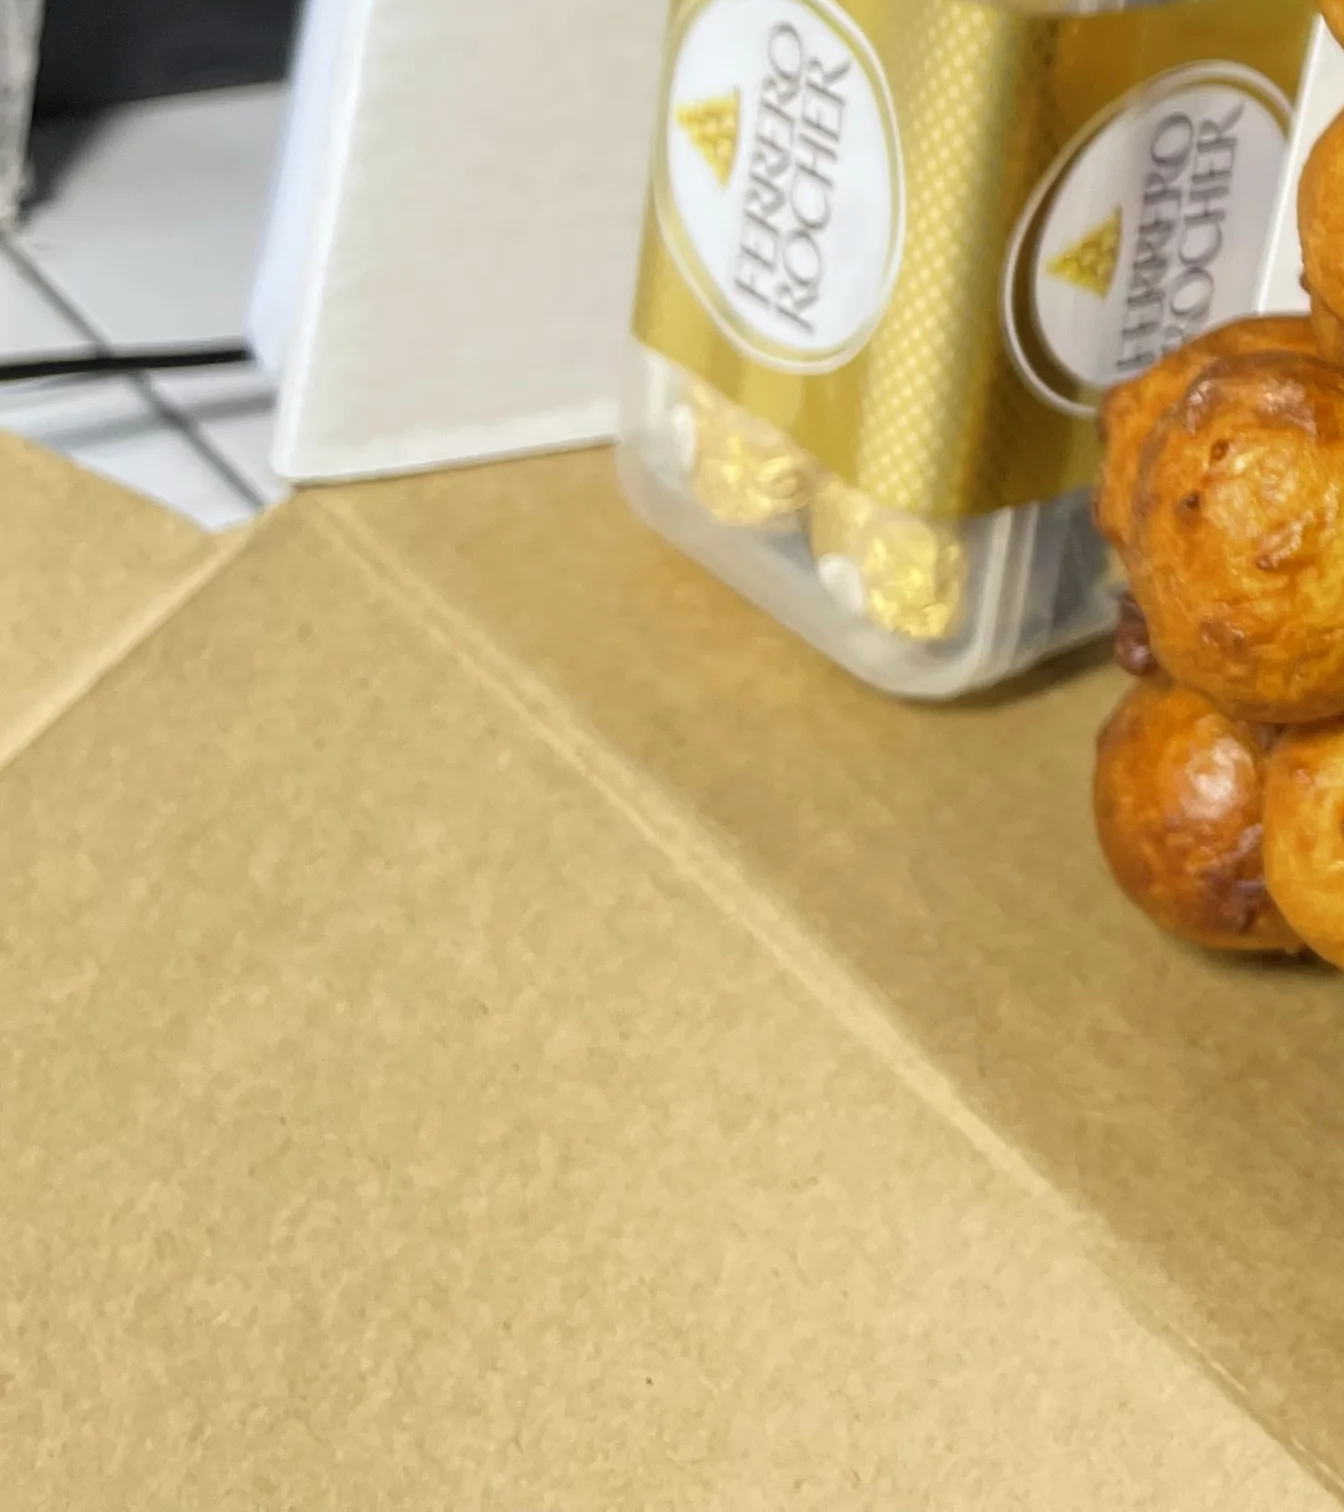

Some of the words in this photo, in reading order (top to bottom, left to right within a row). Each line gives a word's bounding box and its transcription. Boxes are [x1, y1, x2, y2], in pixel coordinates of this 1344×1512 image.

[733, 20, 803, 305] FERRERO
[773, 56, 851, 332] ROCHER
[1115, 111, 1195, 372] FERRERO
